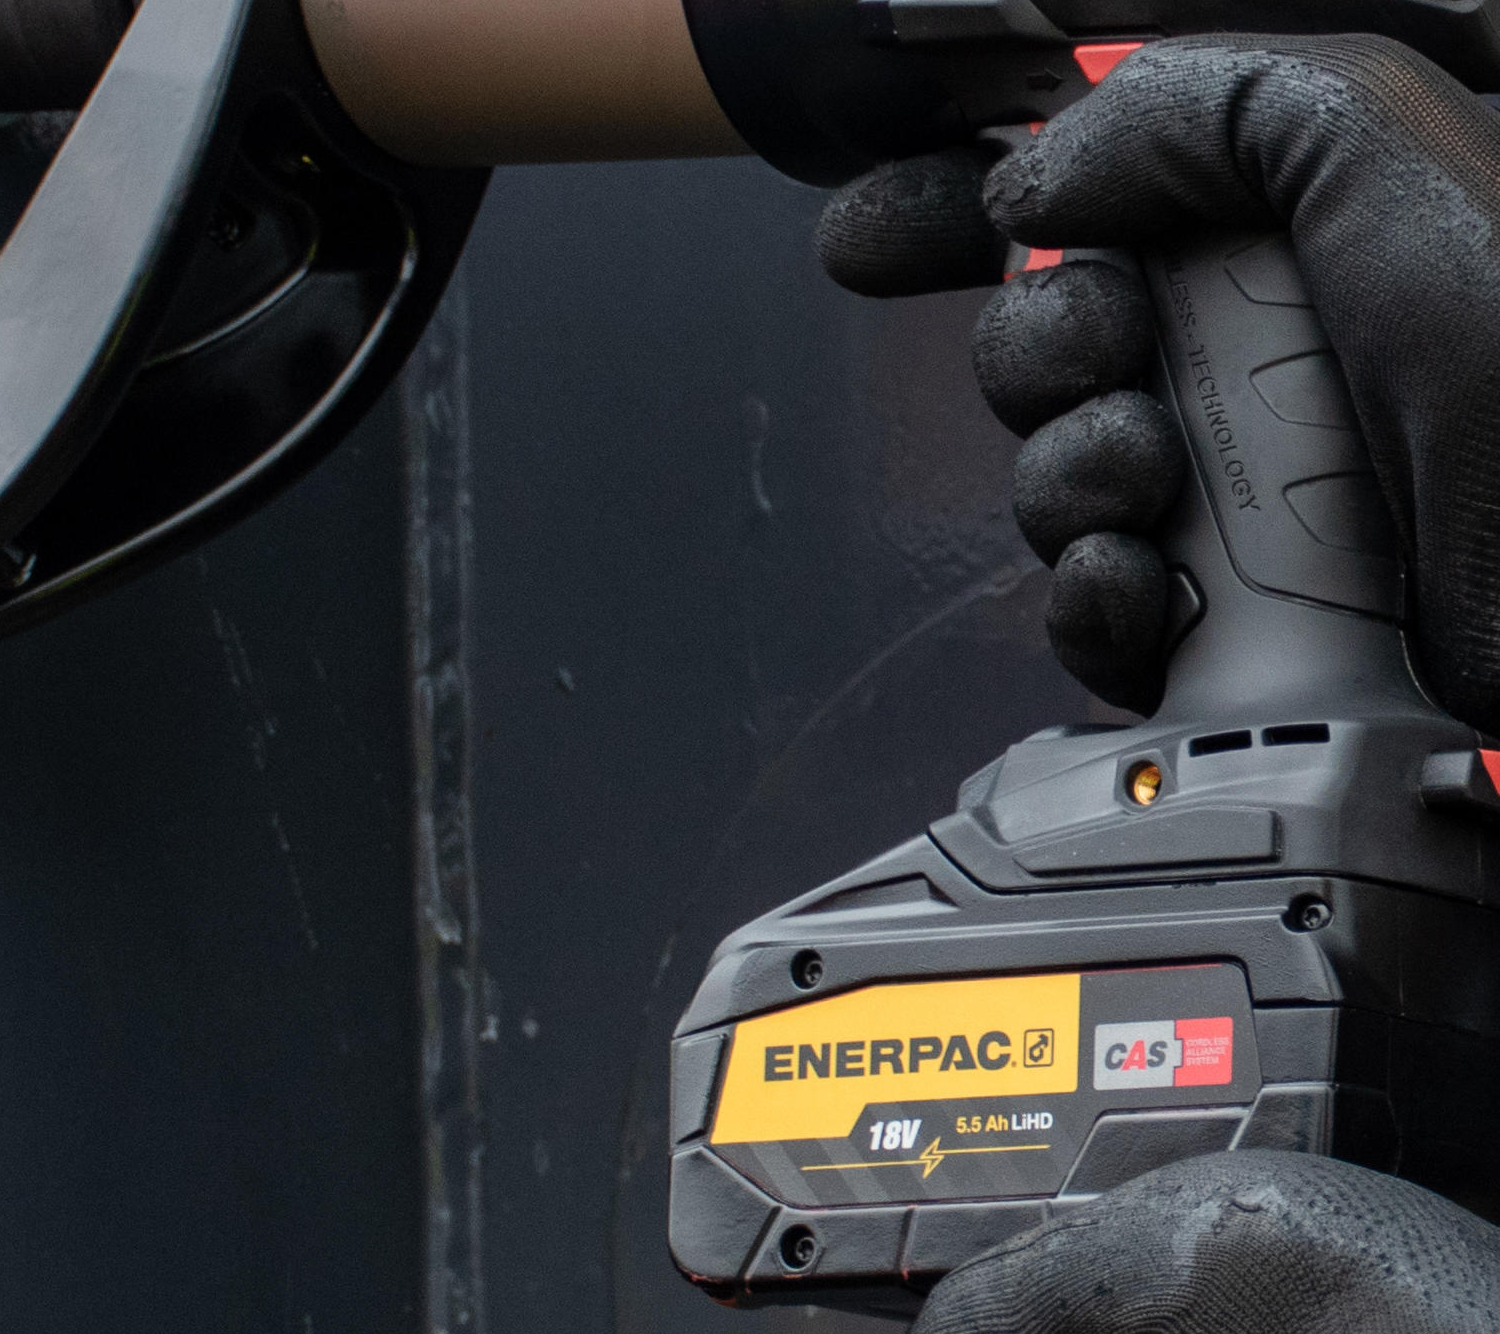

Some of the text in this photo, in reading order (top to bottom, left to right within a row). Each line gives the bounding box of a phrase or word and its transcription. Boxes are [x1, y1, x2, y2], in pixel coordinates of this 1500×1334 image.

[763, 1029, 1012, 1083] ENERPAC
[1104, 1039, 1169, 1072] CAS
[869, 1118, 922, 1151] 18V
[955, 1112, 1054, 1134] 5.5 Ah LiHD
